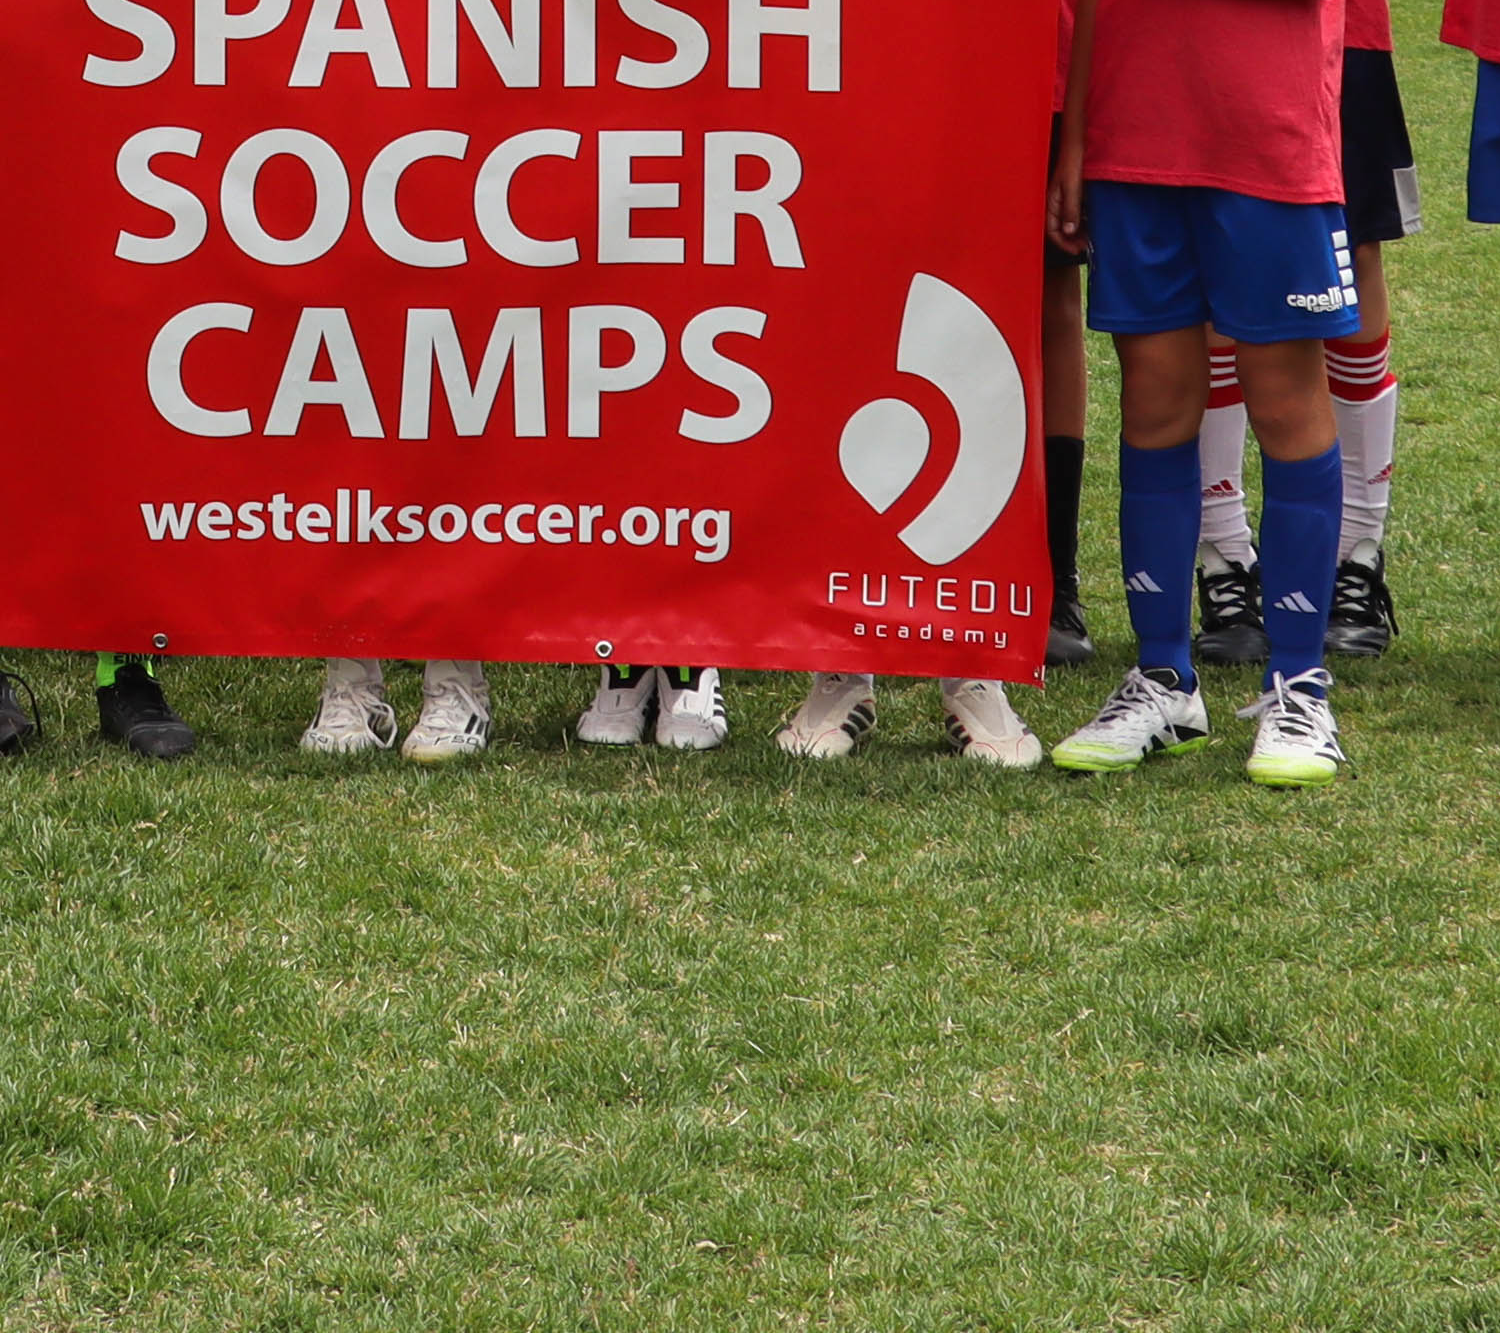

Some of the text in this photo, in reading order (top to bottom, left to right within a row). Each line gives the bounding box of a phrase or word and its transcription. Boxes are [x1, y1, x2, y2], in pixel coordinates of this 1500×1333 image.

[114, 126, 806, 269] SOCCER
[1286, 286, 1343, 312] capelli
[147, 301, 773, 445] CAMPS
[140, 488, 732, 563] westelksoccer.org
[828, 571, 1032, 617] FUTEDU
[853, 622, 1007, 649] academy
